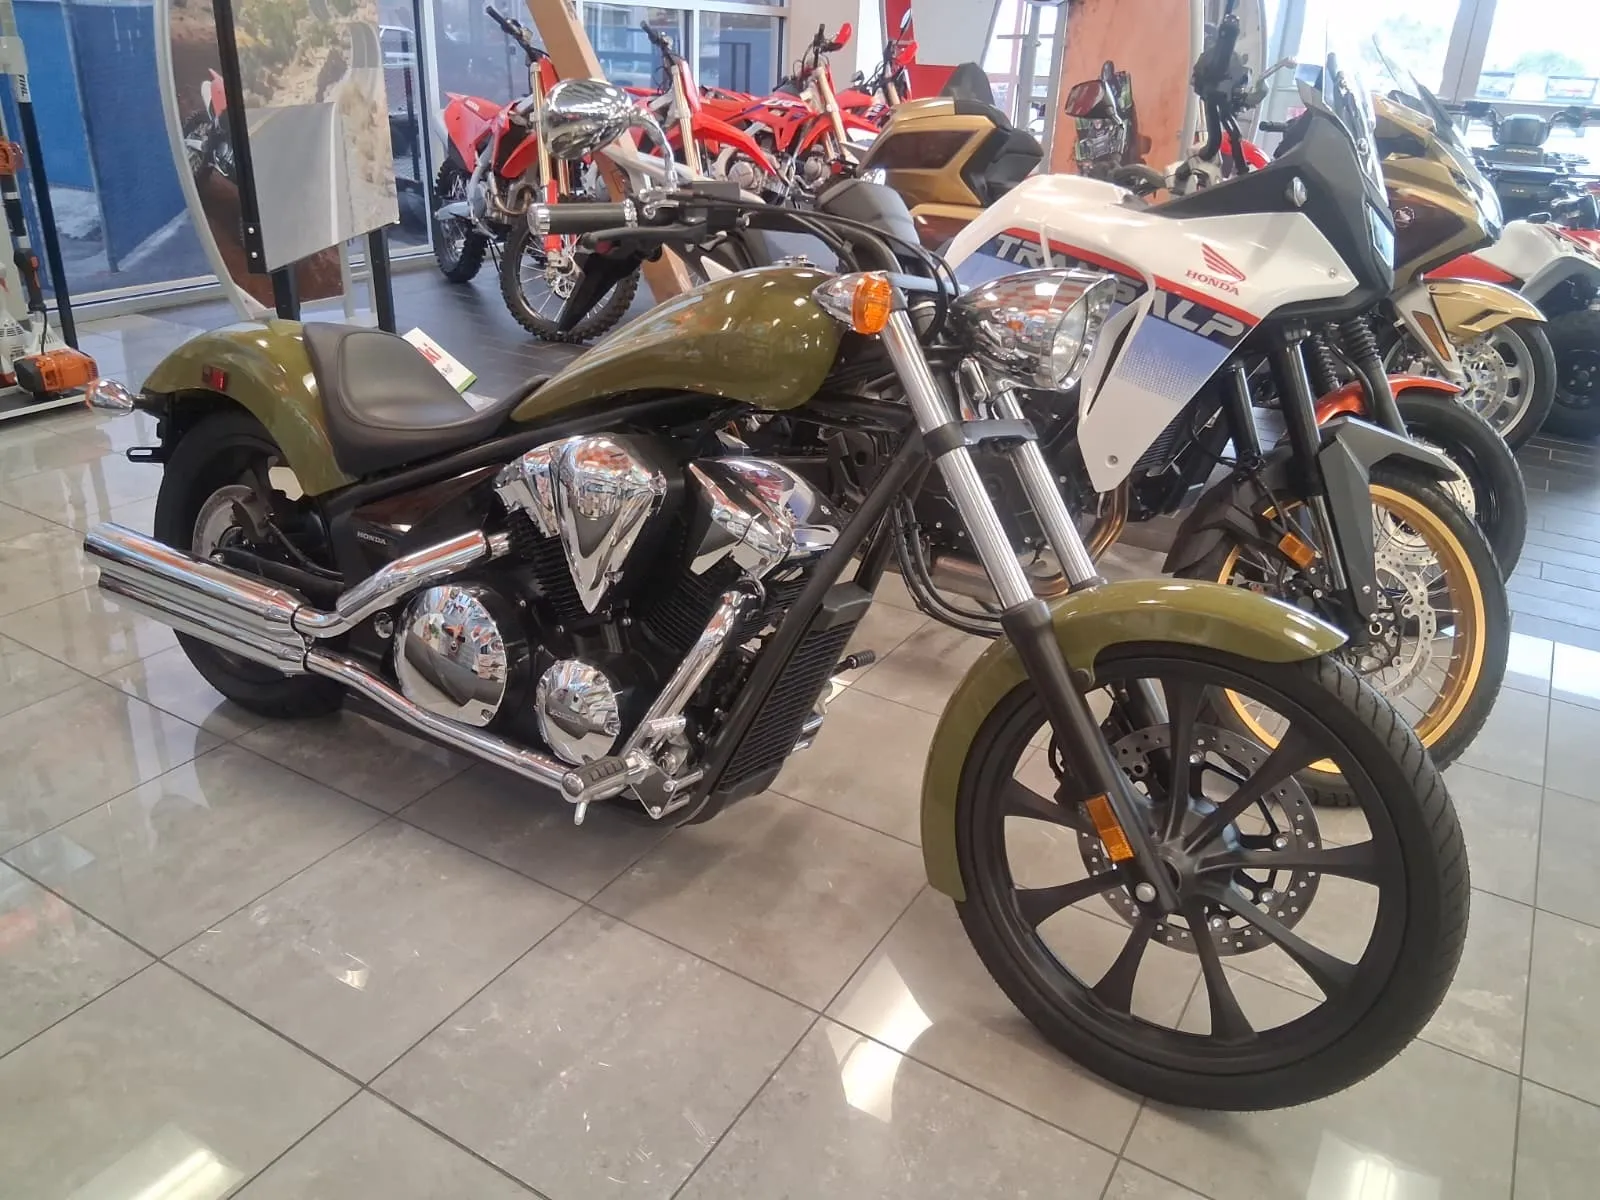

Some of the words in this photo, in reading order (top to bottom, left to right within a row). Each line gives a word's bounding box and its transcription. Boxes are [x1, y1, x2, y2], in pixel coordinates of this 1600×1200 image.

[18, 73, 29, 97] TIHL
[1185, 269, 1240, 296] HONDA
[357, 531, 387, 545] HONDA
